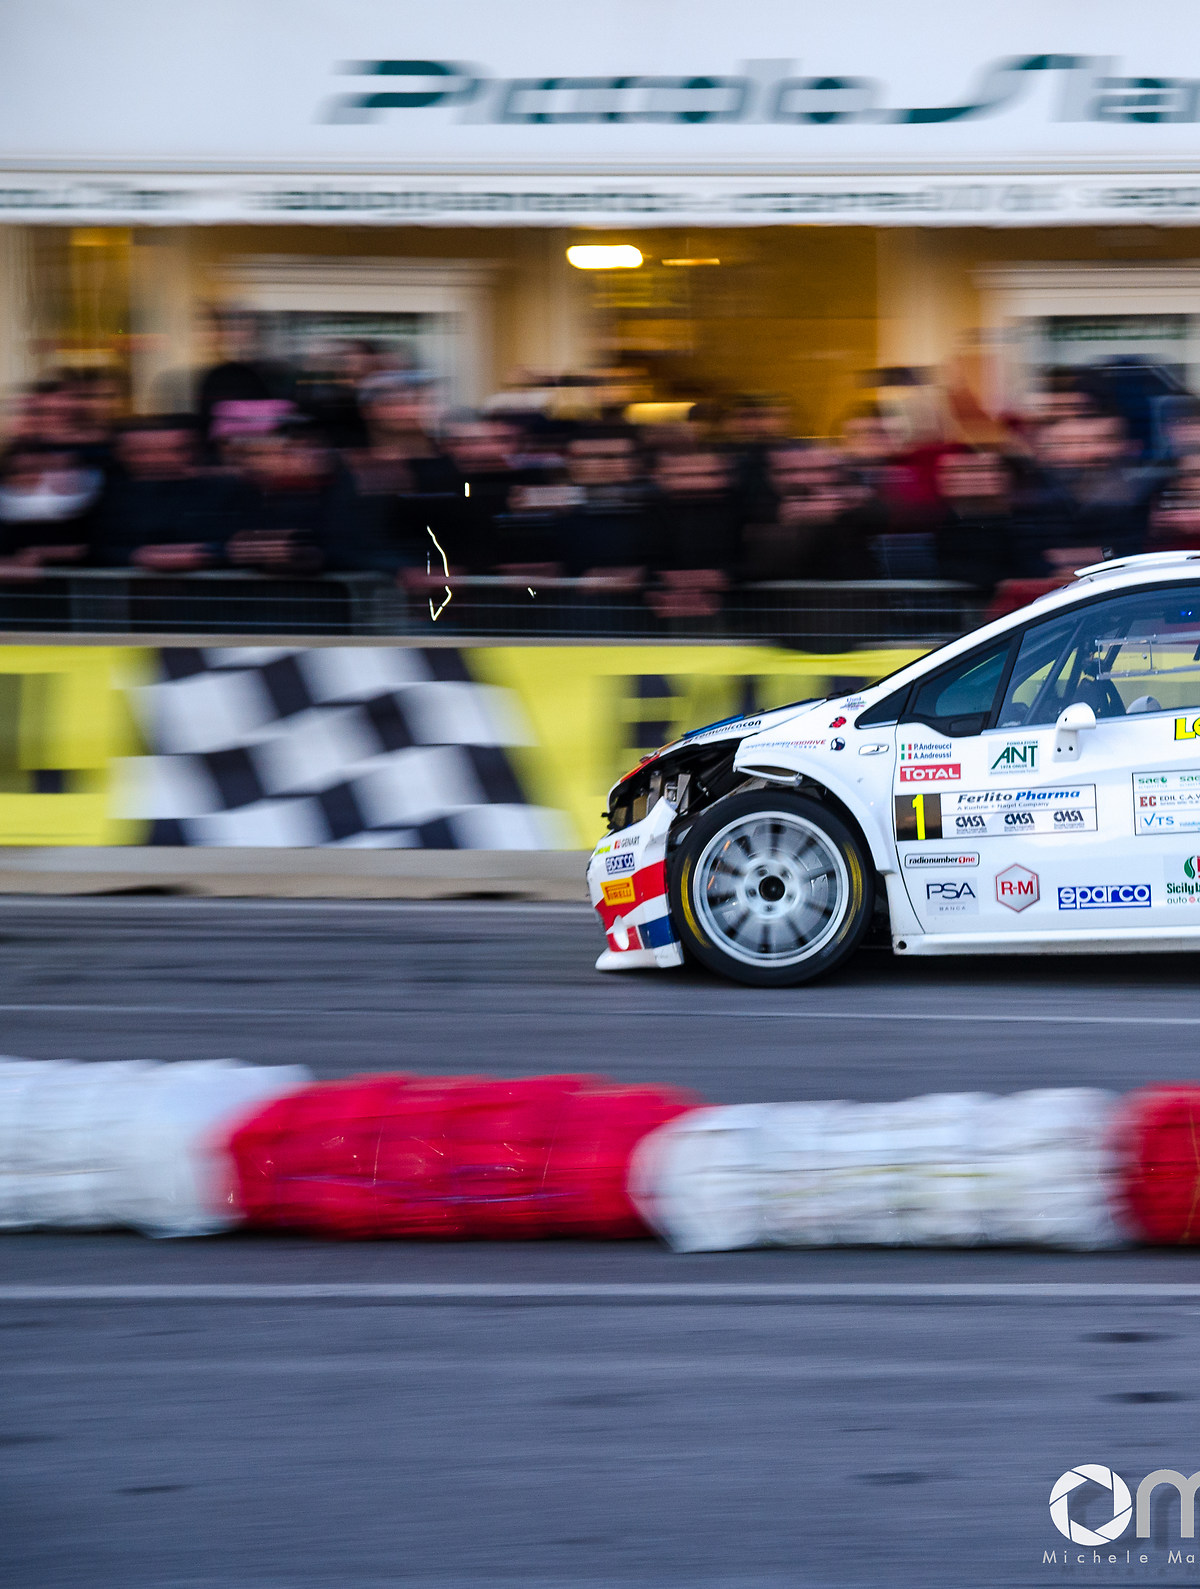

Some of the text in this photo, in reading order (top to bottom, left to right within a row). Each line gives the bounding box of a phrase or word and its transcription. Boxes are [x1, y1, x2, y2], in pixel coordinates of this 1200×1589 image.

[991, 745, 1038, 770] ANT
[901, 767, 960, 781] TOTAL
[957, 790, 1081, 804] Ferlito Pharma
[1139, 795, 1157, 807] EC
[912, 794, 926, 841] 1
[926, 882, 976, 900] PSA
[1001, 880, 1034, 895] R-M
[1059, 885, 1150, 910] sparco
